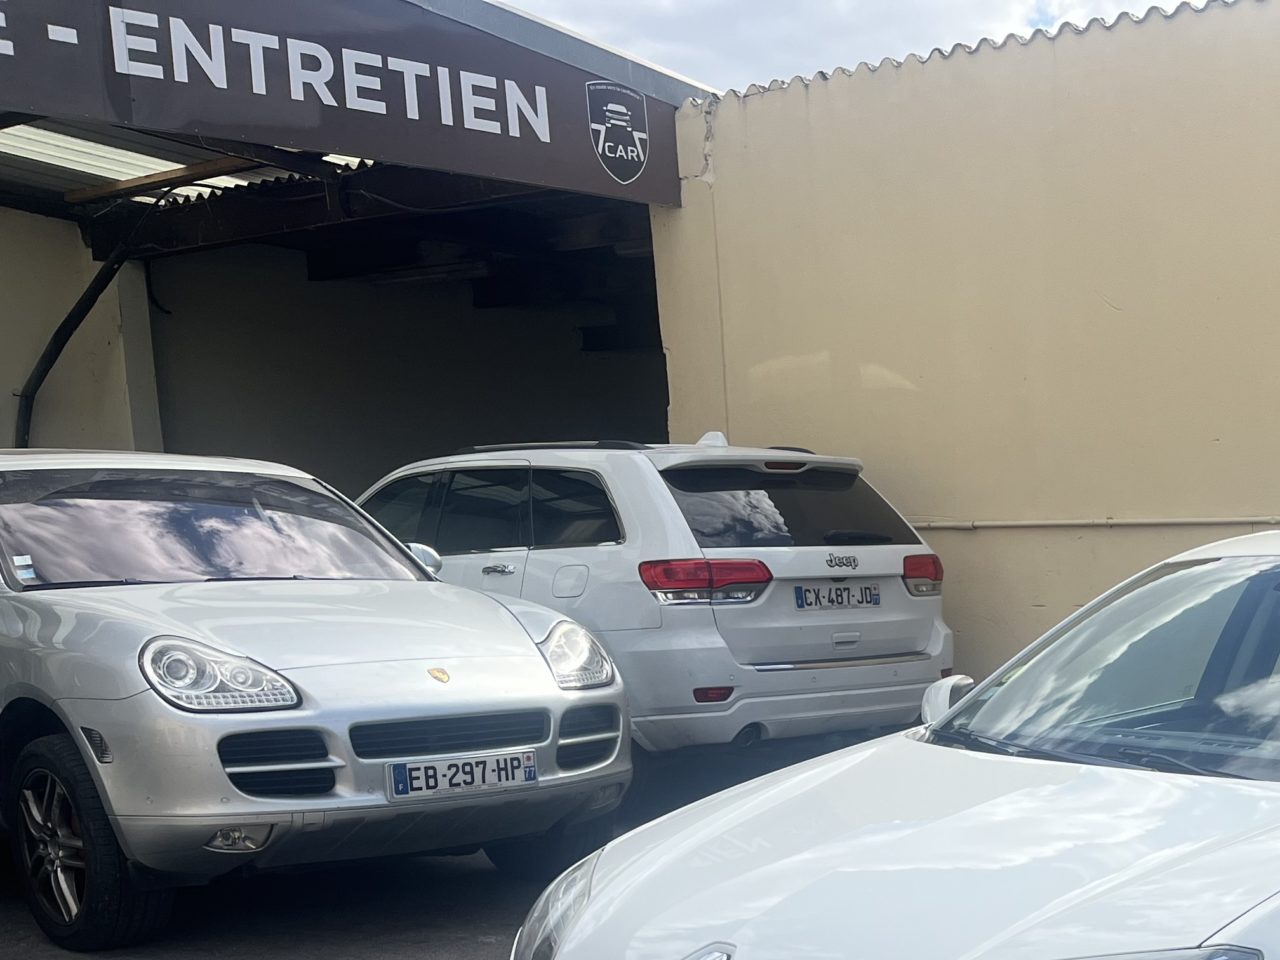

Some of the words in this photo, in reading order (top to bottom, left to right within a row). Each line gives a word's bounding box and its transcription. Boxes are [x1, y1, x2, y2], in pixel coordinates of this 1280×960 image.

[108, 5, 551, 143] ENTRETIEN
[826, 553, 859, 570] Jeep
[803, 586, 873, 606] CX-487-JD
[407, 756, 522, 792] EB-297-HP
